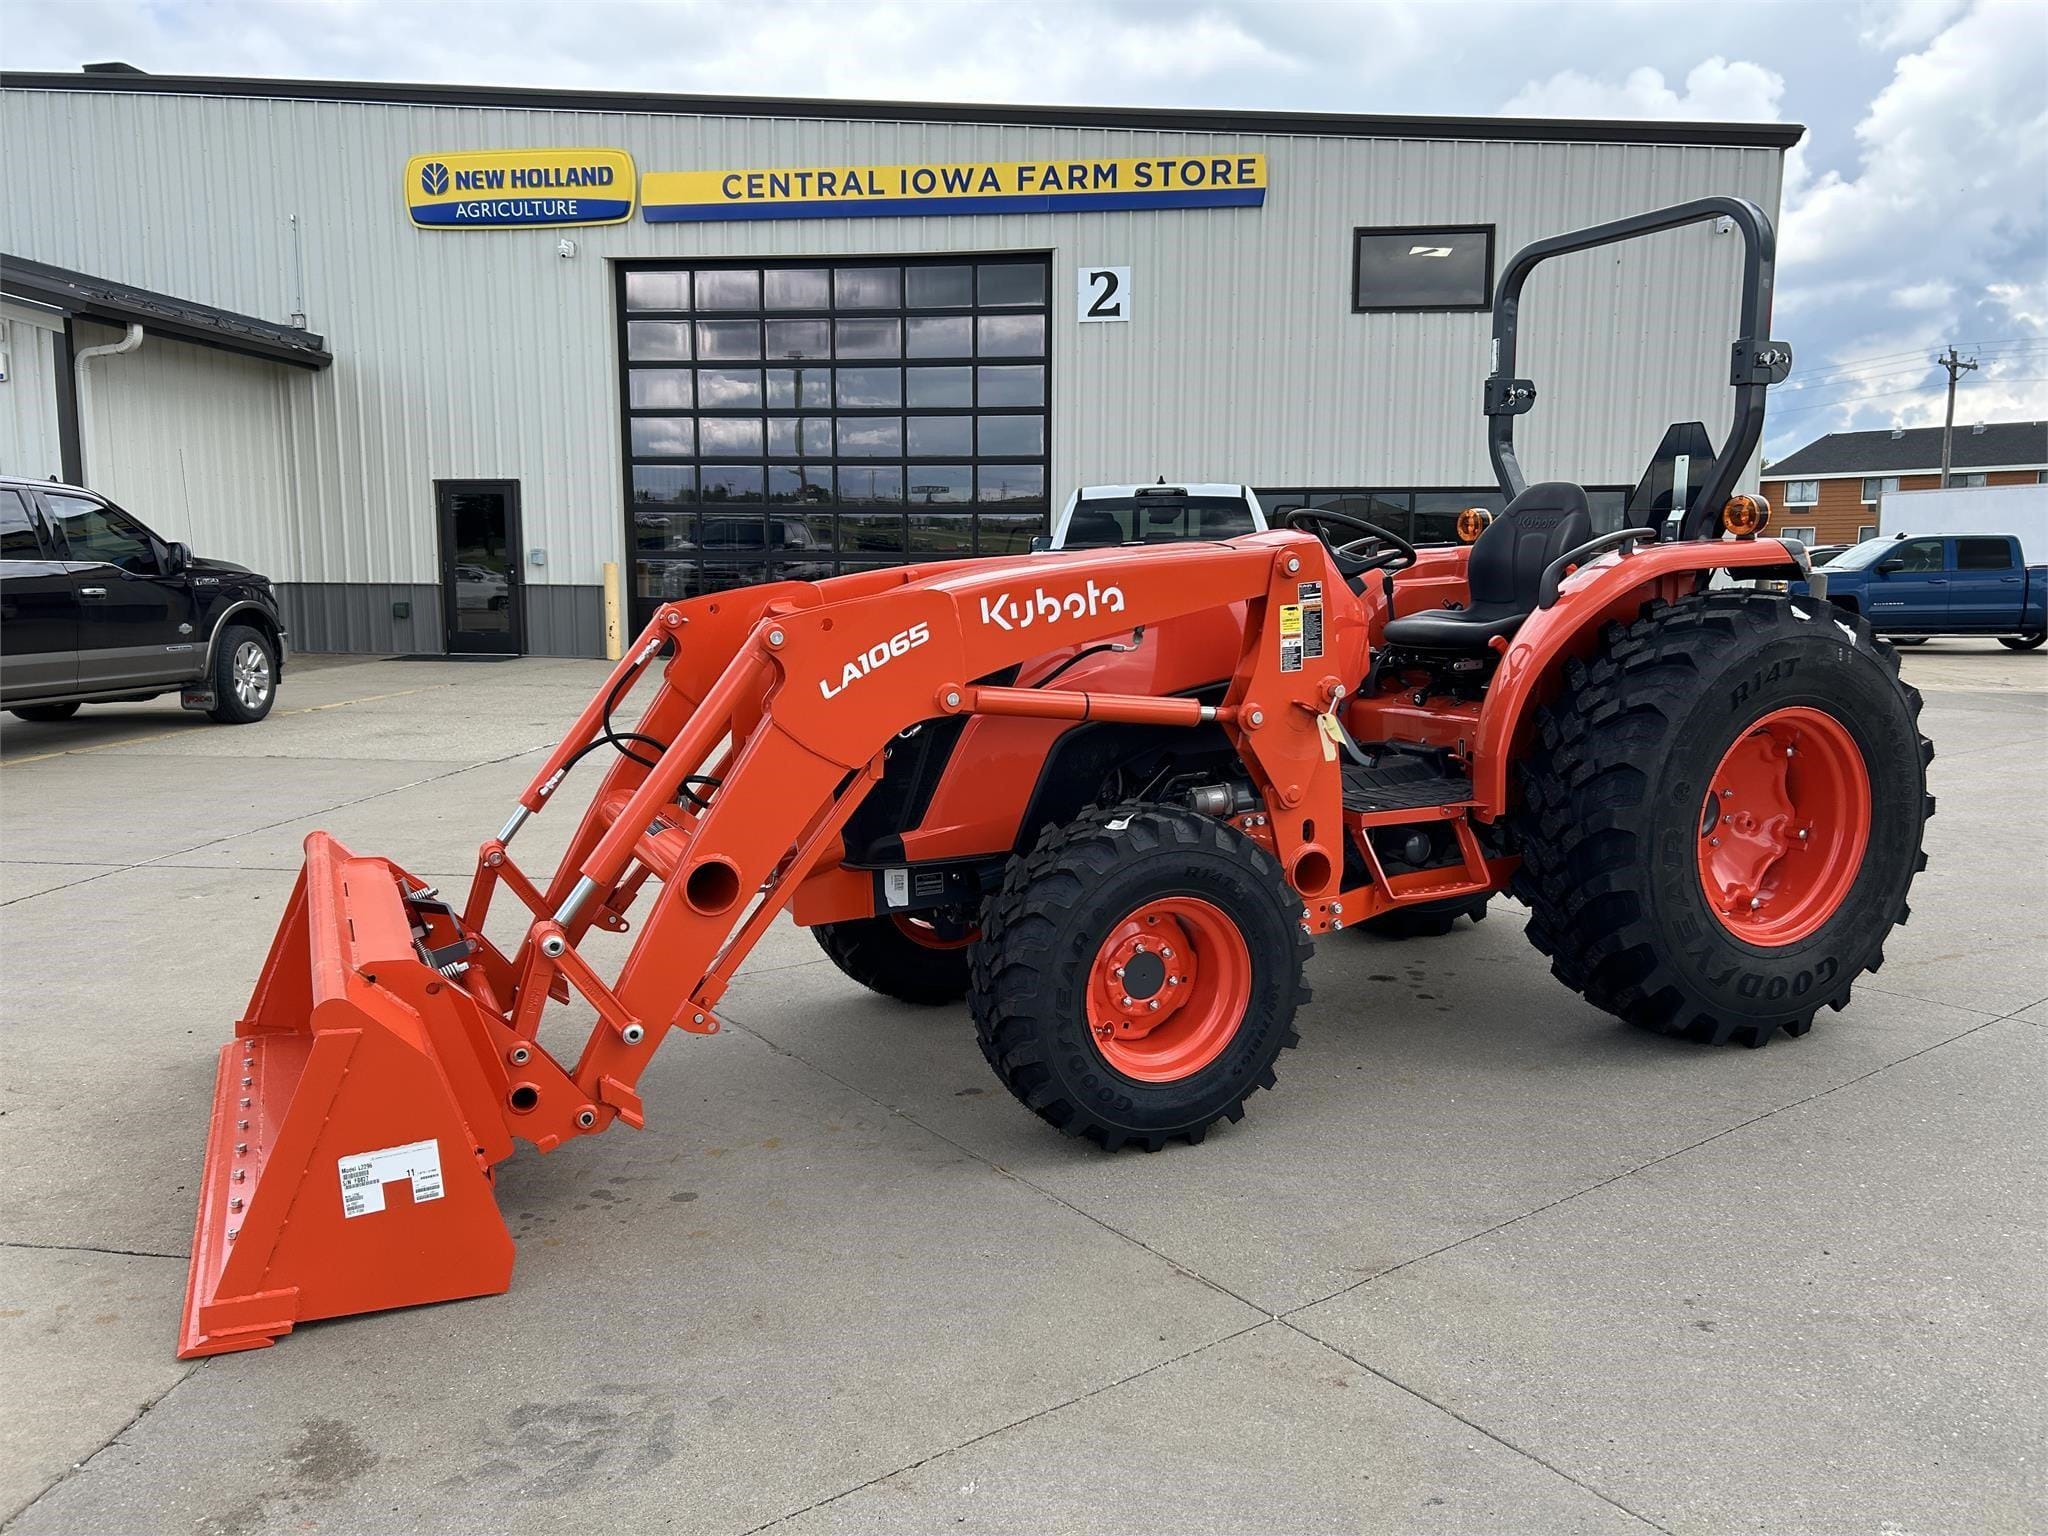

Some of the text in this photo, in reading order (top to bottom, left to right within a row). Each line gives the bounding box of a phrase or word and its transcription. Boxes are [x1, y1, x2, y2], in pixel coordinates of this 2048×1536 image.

[455, 165, 614, 190] NEW HOLLAND
[722, 158, 1257, 200] CENTRAL IOWA FARM STORE
[455, 200, 578, 219] AGRICULTURE
[1087, 271, 1120, 317] 2
[1518, 515, 1558, 529] Kubota
[980, 579, 1125, 631] Kubota
[819, 621, 930, 699] LA1065
[1730, 656, 1802, 712] R14T
[1183, 865, 1237, 890] R14T
[1662, 827, 1840, 1001] GOODYEAR
[1055, 931, 1134, 1112] GOODYEAR
